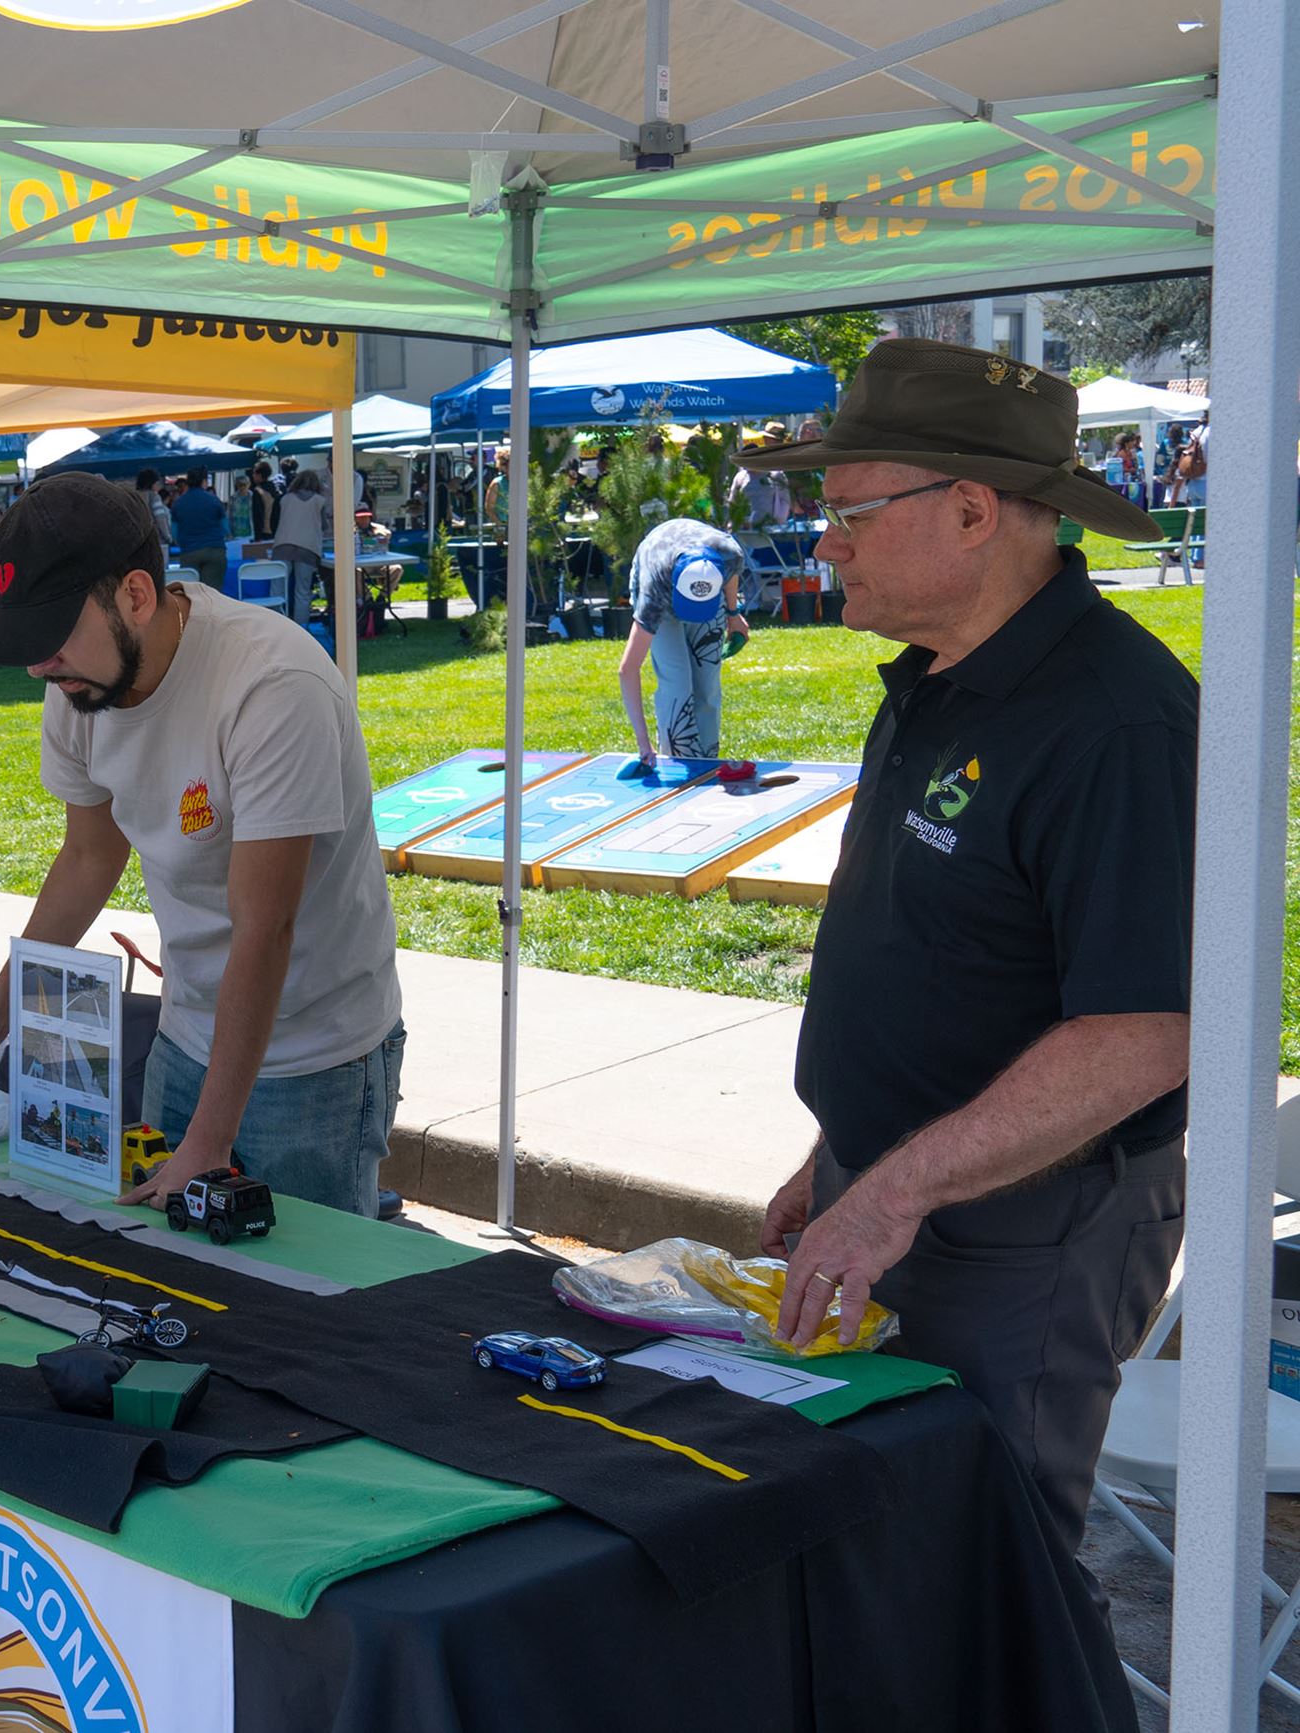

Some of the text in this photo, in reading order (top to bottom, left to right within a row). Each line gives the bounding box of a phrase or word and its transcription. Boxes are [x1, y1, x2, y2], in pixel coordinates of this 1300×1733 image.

[686, 395, 725, 407] Watch
[904, 809, 958, 847] Watsonville
[916, 831, 953, 855] CALIFORNIA
[210, 1192, 227, 1203] POLICE
[245, 1221, 266, 1230] POLICE
[660, 1365, 698, 1380] Escu
[690, 1358, 744, 1375] School
